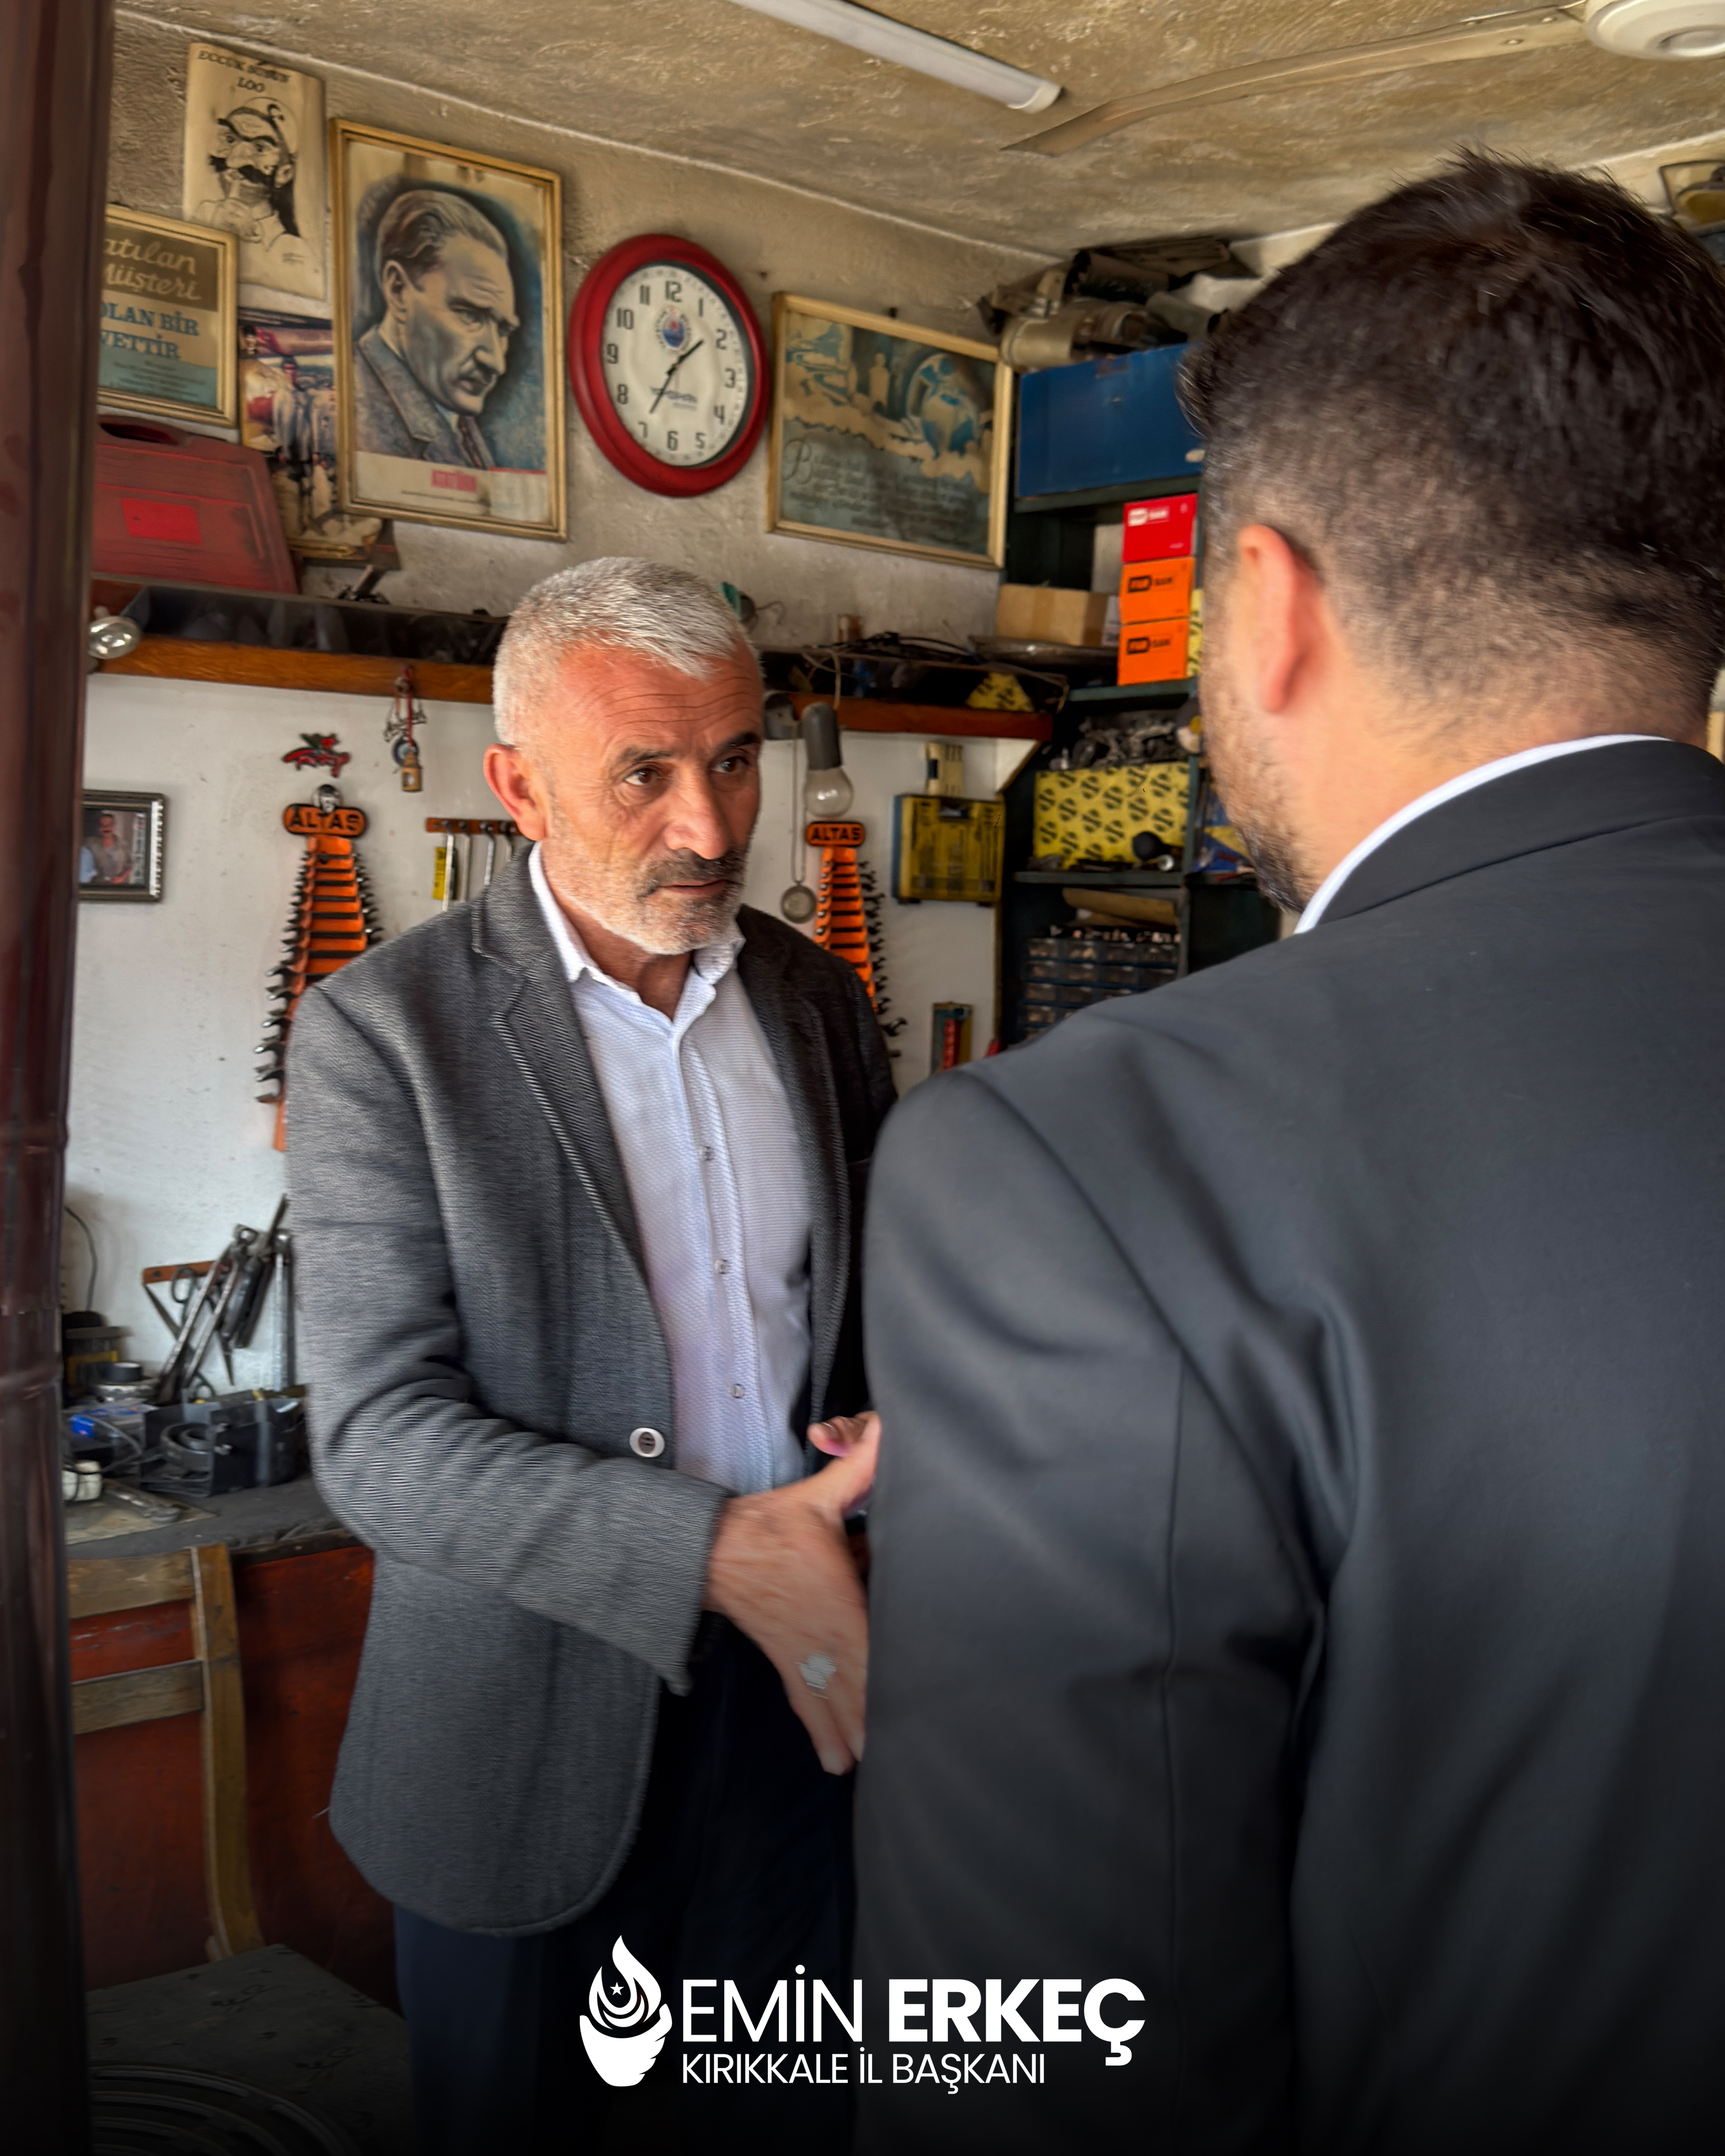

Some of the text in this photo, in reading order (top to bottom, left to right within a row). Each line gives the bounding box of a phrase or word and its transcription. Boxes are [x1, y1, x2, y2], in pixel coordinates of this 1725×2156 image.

[639, 284, 651, 306] 11
[666, 281, 682, 302] 12
[699, 298, 704, 317] 1
[159, 309, 200, 337] BİR
[617, 307, 635, 330] 10
[716, 328, 727, 350] 2
[606, 343, 619, 364] 9
[725, 367, 736, 389] 3
[617, 383, 629, 405] 8
[713, 405, 725, 425] 4
[638, 421, 648, 439] 7
[667, 430, 679, 451] 6
[695, 432, 705, 449] 5
[811, 826, 860, 841] ALTAS
